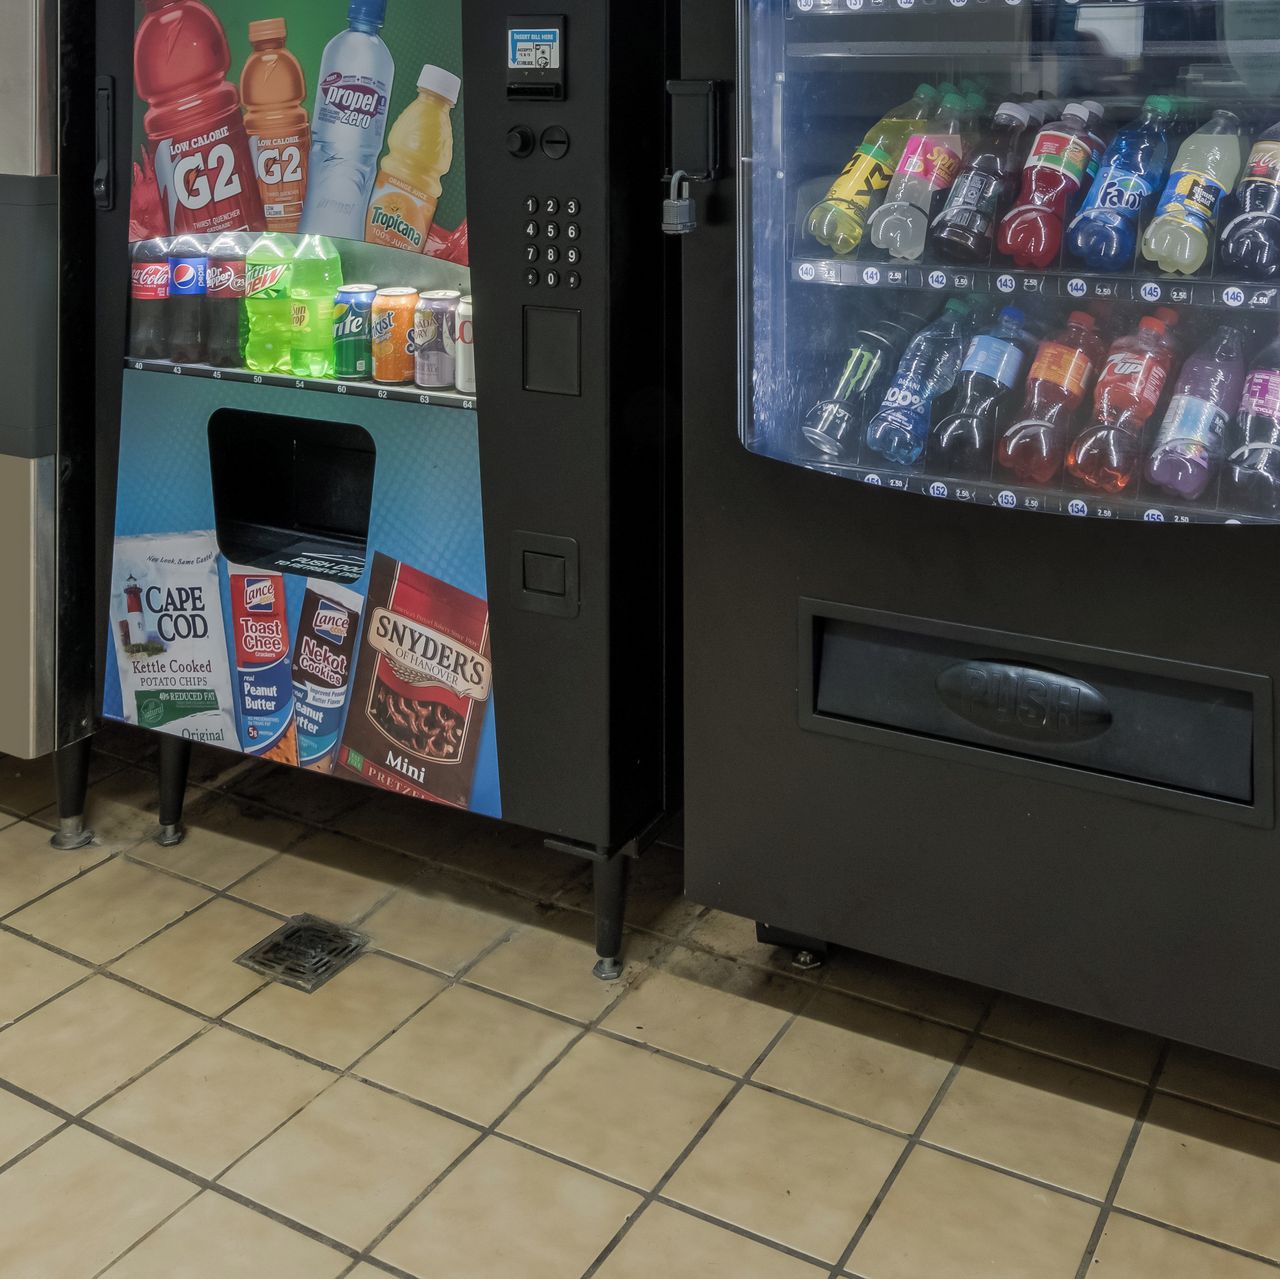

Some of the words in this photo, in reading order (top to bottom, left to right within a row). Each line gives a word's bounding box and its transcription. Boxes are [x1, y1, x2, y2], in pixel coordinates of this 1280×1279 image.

[325, 85, 379, 114] propel
[339, 110, 372, 130] zero
[170, 140, 190, 156] LOW
[190, 126, 230, 150] CALORIE
[257, 137, 272, 147] LOW
[272, 135, 300, 146] CALORIE
[257, 146, 303, 185] G2
[173, 143, 242, 210] G2
[388, 176, 413, 193] ORANGE
[412, 188, 428, 201] JUICE
[1192, 185, 1217, 204] Minute
[527, 199, 532, 211] 1
[547, 200, 554, 212] 2
[1192, 192, 1212, 208] Maid
[567, 201, 575, 213] 3
[192, 217, 213, 229] THIRST
[212, 209, 241, 225] QUENCHER
[371, 205, 423, 247] Tropicana
[526, 223, 533, 235] 4
[547, 225, 554, 237] 5
[568, 225, 576, 237] 6
[527, 248, 533, 260] 7
[547, 248, 554, 261] 8
[568, 250, 576, 262] 9
[197, 264, 206, 287] pepsi
[799, 266, 815, 278] 140
[863, 270, 880, 281] 141
[547, 273, 554, 285] 0
[928, 274, 946, 285] 142
[997, 278, 1015, 289] 143
[1068, 282, 1086, 293] 144
[1097, 287, 1112, 296] 2.50
[1141, 286, 1159, 298] 145
[1223, 291, 1243, 302] 146
[1252, 295, 1269, 304] 2.50
[134, 361, 143, 370] 40
[173, 366, 182, 374] 43
[212, 371, 222, 380] 45
[253, 376, 263, 384] 50
[295, 380, 305, 388] 54
[337, 385, 347, 394] 60
[378, 390, 388, 399] 62
[420, 395, 430, 404] 63
[463, 400, 473, 409] 64
[889, 479, 903, 488] 2.50
[930, 486, 946, 497] 152
[956, 490, 970, 498] 2.50
[998, 494, 1015, 506] 153
[1025, 500, 1039, 508] 2.50
[1069, 503, 1086, 515] 154
[1097, 509, 1112, 518] 2.50
[1145, 512, 1162, 522] 155
[145, 586, 206, 614] CAPE
[245, 583, 275, 606] Lance
[313, 611, 350, 629] Lance
[157, 614, 210, 642] COD
[240, 618, 282, 637] Toast
[243, 634, 282, 652] Chee
[302, 636, 347, 675] Nekot
[376, 615, 486, 686] SNYDER'S
[132, 660, 166, 674] Kettle
[170, 659, 213, 674] Cooked
[300, 656, 342, 687] Cookies
[395, 646, 410, 661] OF
[409, 654, 459, 687] HANOVER
[140, 677, 177, 687] POTATO
[179, 677, 208, 687] CHIPS
[244, 682, 278, 697] Peanut
[171, 692, 203, 701] REDUCED
[204, 692, 216, 701] FAT
[966, 668, 1082, 734] PUSH
[245, 697, 276, 711] Butter
[295, 701, 324, 723] eanut
[182, 728, 225, 743] Original
[385, 750, 427, 784] Mini
